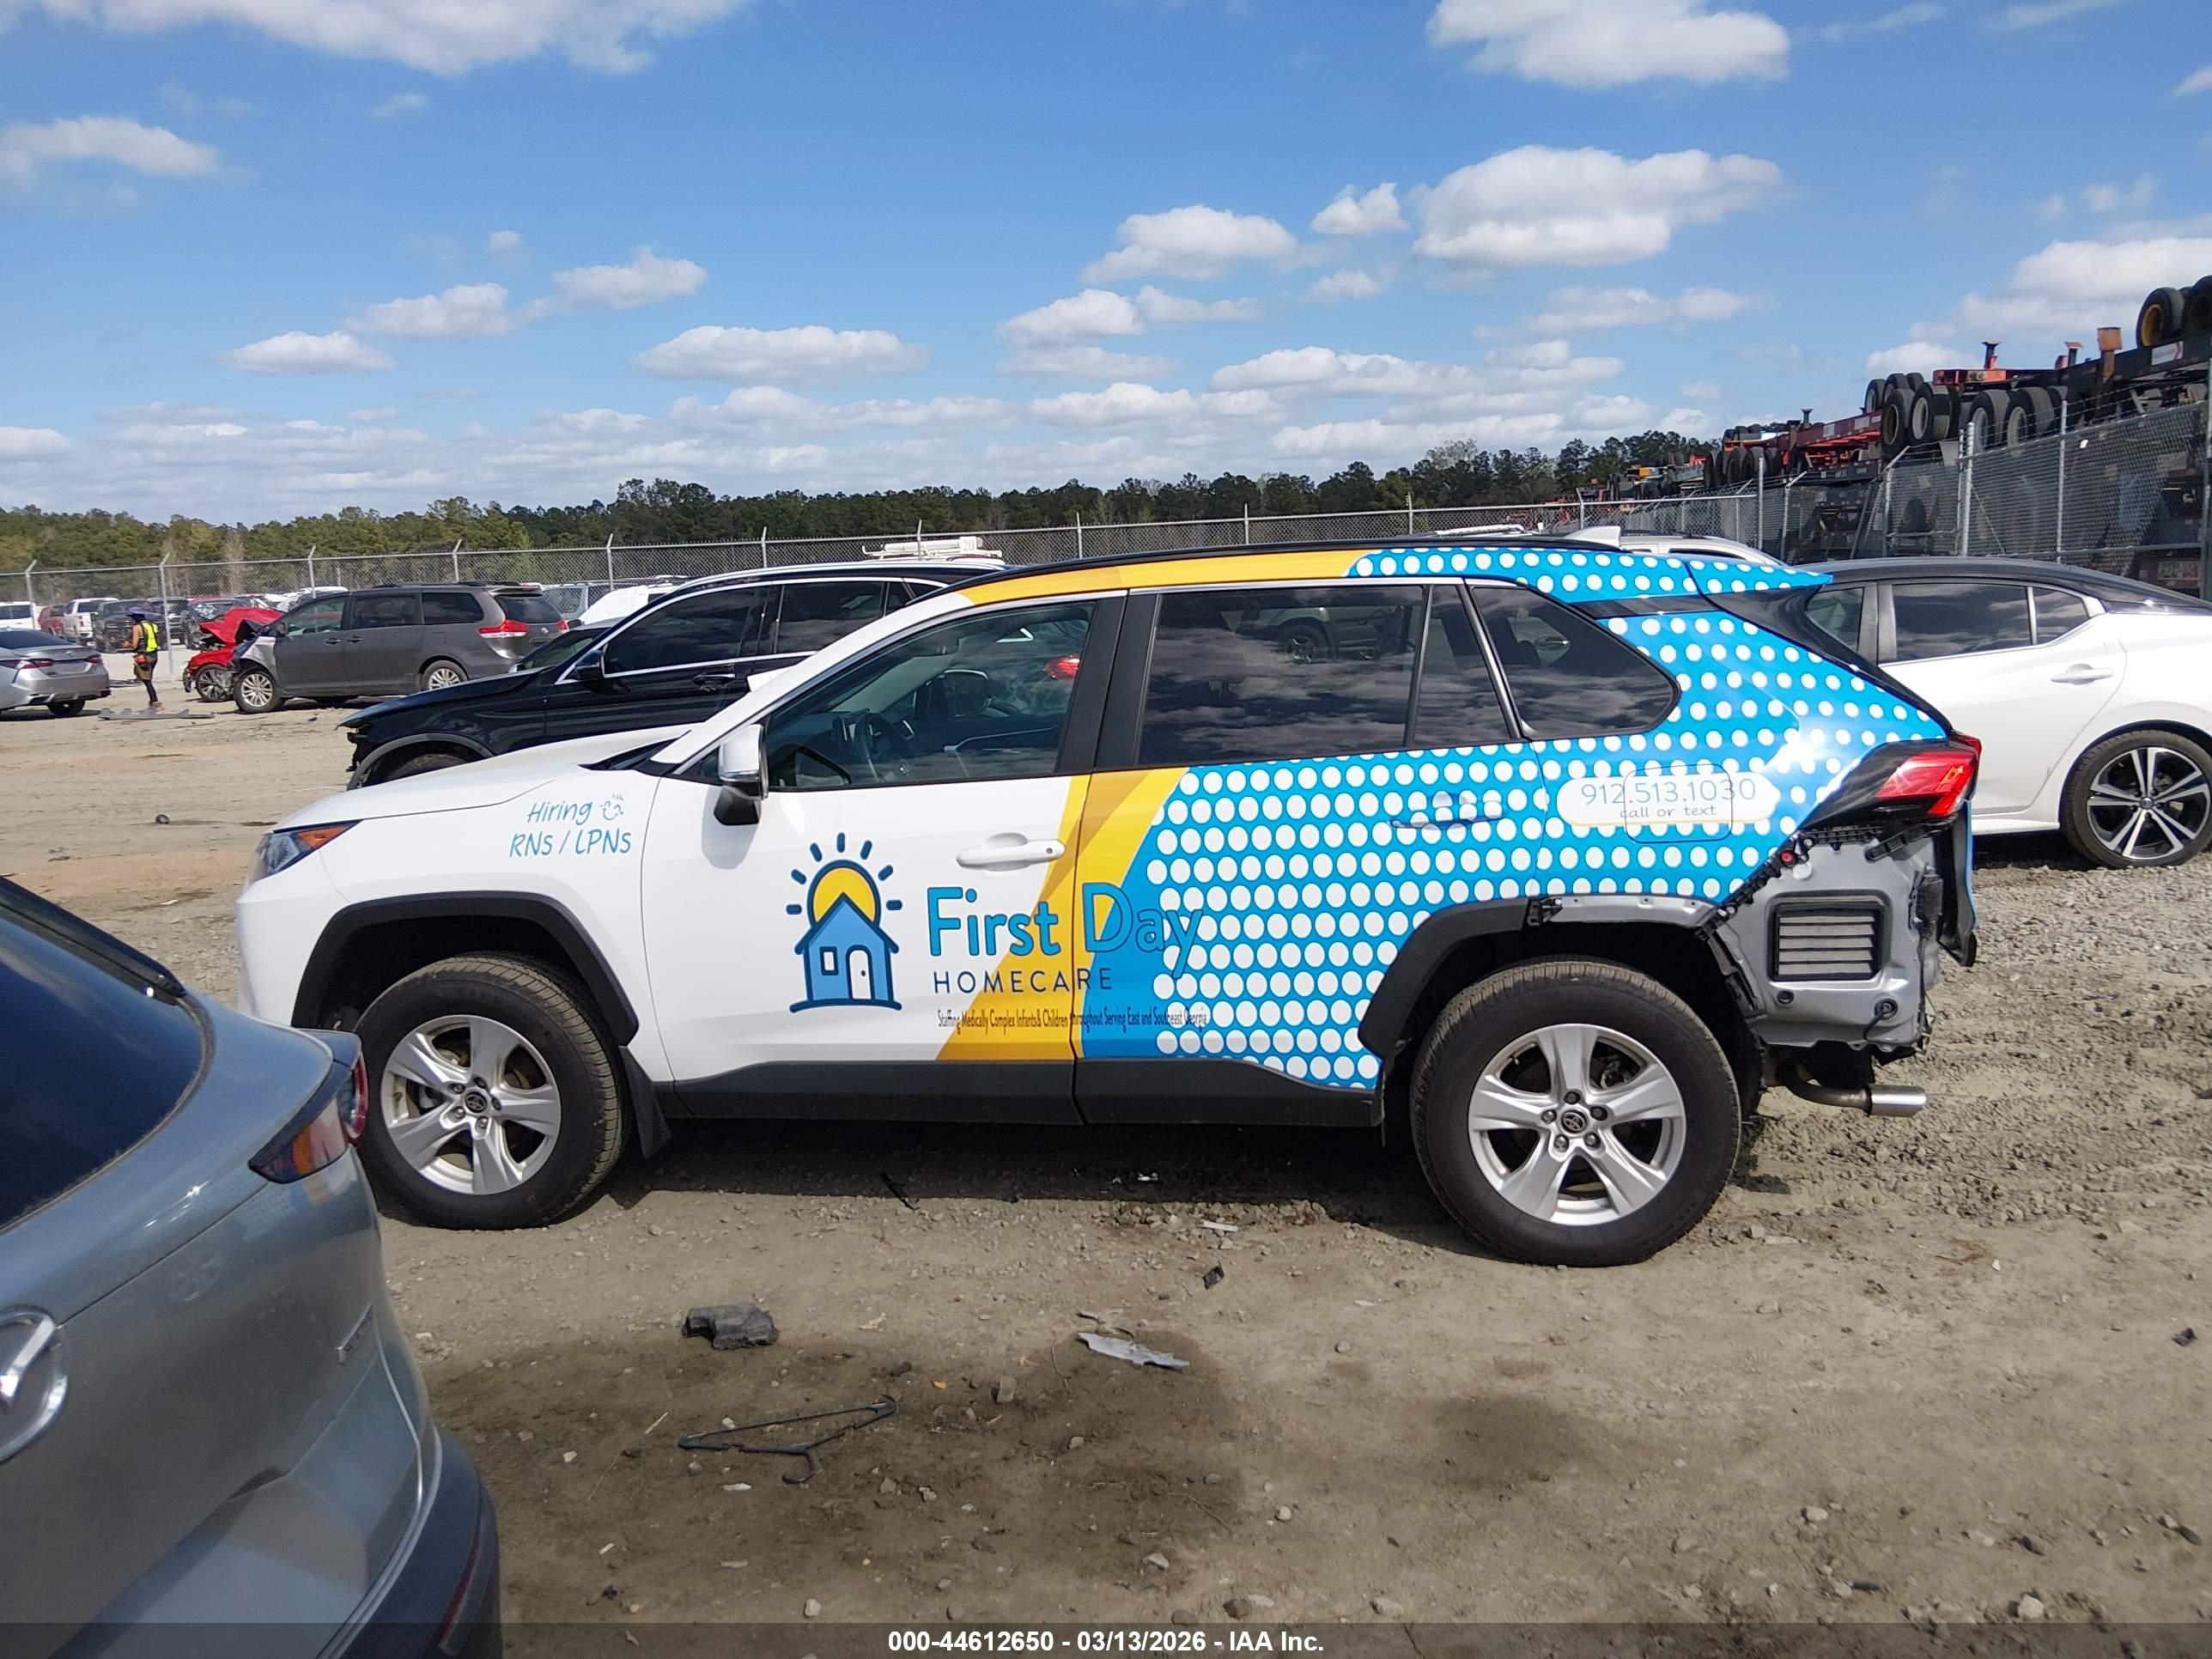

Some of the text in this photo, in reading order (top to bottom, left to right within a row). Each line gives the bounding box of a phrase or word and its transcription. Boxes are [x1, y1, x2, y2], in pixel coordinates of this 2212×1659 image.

[1581, 777, 1756, 805] 912.513.1030
[526, 800, 593, 825] Hiring
[1620, 805, 1717, 819] call or text
[927, 882, 1203, 979] First Day
[933, 968, 1113, 994] HOMECARE
[937, 1008, 961, 1035] Staffing
[961, 1008, 988, 1035] Medically
[989, 1008, 1015, 1035] Complex
[1042, 1008, 1068, 1028] Children
[1103, 1006, 1127, 1033] Serving
[1127, 1006, 1139, 1025] East
[1141, 1006, 1152, 1025] and
[1153, 1006, 1183, 1025] Southeast
[1184, 1006, 1206, 1033] Georgia
